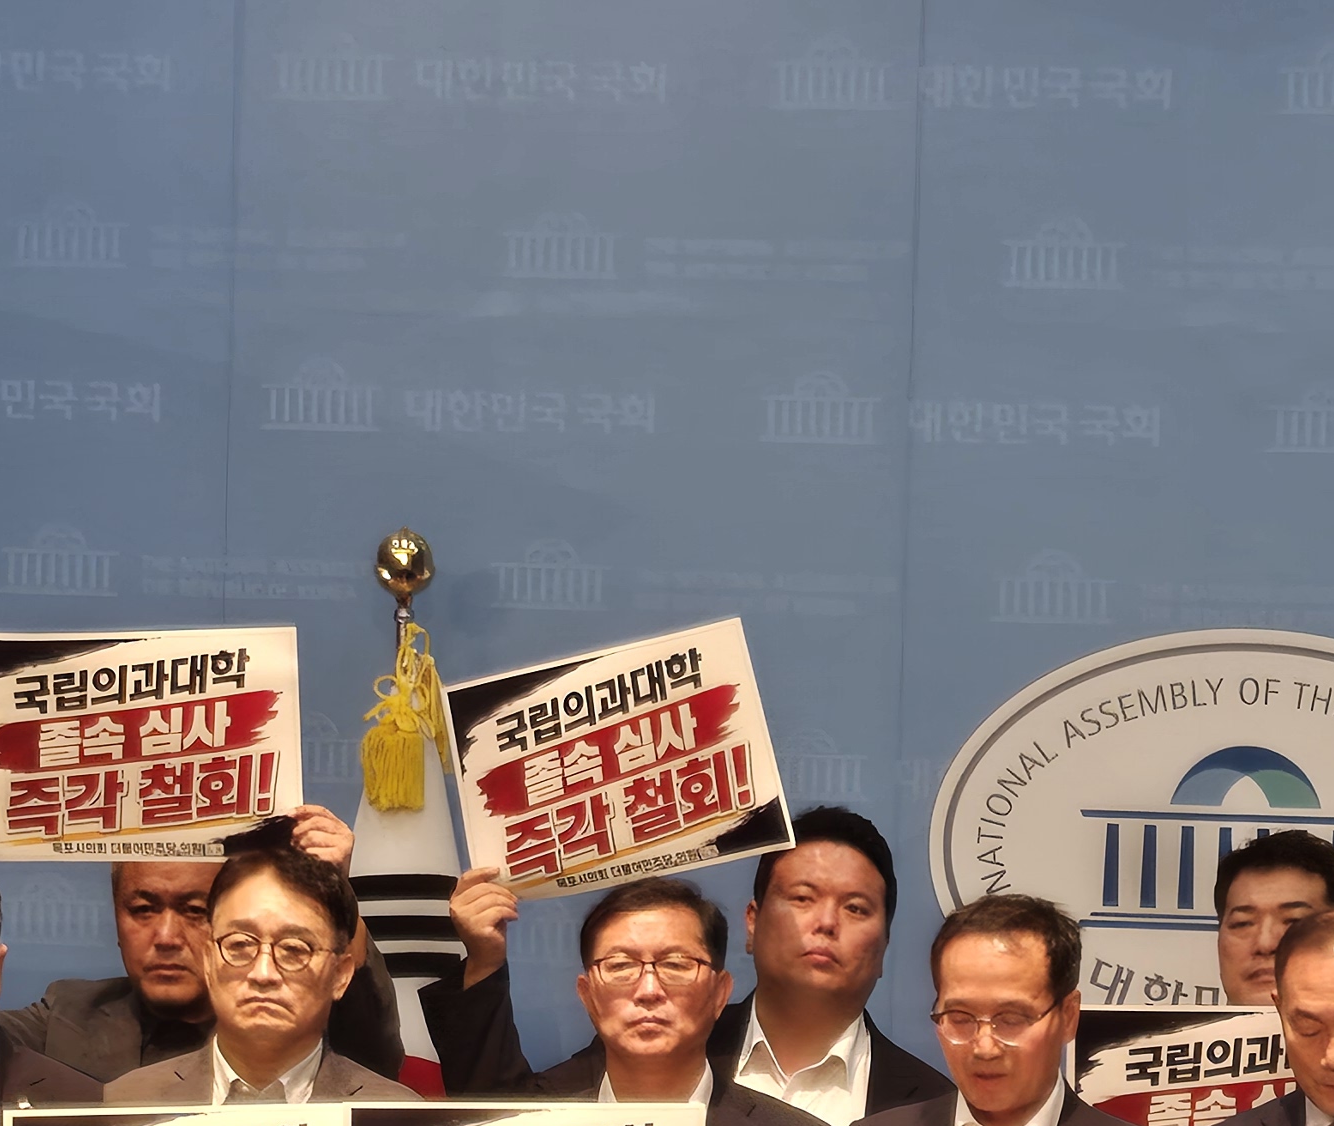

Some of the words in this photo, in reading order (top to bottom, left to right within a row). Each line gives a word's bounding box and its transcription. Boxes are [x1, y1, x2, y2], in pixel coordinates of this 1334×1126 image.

[14, 647, 250, 715] 국립의과대학
[495, 648, 702, 752] 국립의과대학
[37, 716, 123, 768] 졸속
[139, 699, 230, 758] 심사
[523, 741, 602, 806] 졸속
[614, 703, 697, 772] 심사
[7, 769, 125, 833] 즉각
[141, 752, 278, 824] 철회!
[504, 792, 613, 876] 즉각
[623, 743, 753, 841] 철회!
[976, 741, 1058, 896] NATIONAL
[1064, 677, 1224, 747] ASSEMBLY
[1239, 677, 1282, 706] OF
[1126, 1034, 1294, 1086] 국립의과
